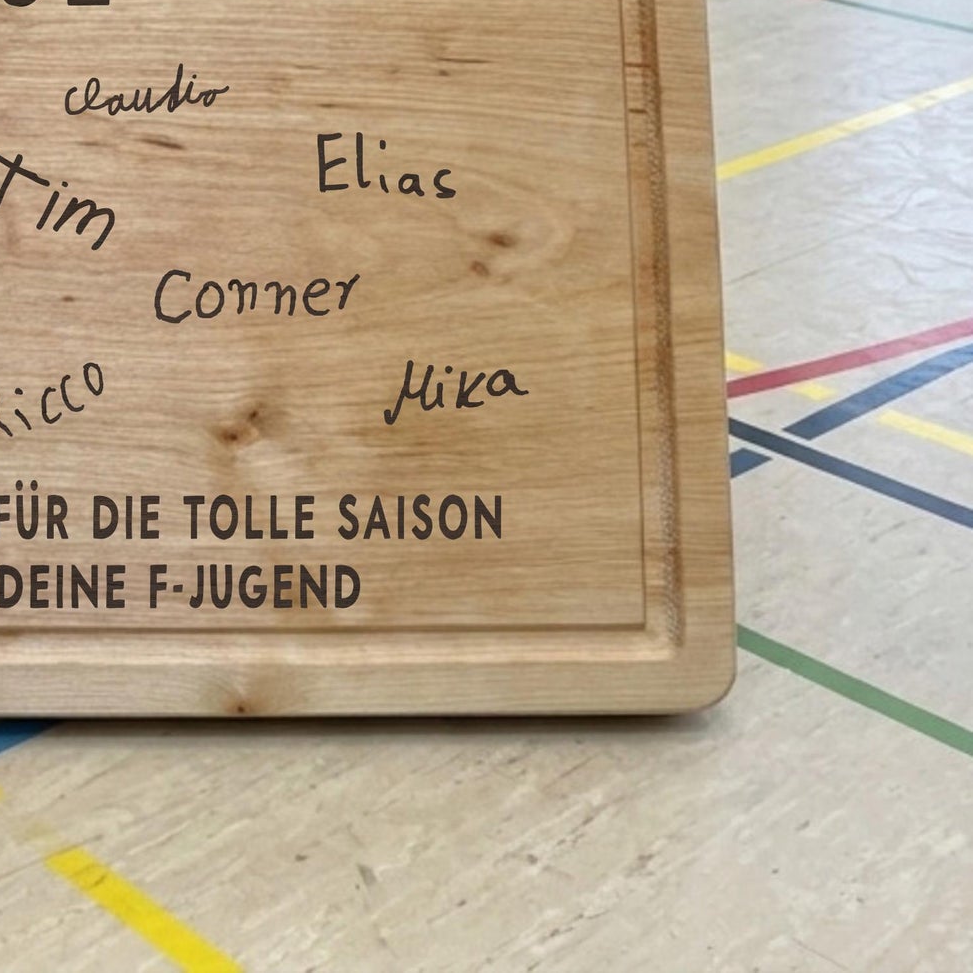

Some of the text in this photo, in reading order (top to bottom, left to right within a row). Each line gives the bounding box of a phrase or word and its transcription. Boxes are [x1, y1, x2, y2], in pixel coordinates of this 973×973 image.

[318, 132, 456, 198] Elias
[155, 270, 360, 323] Conner
[384, 360, 529, 425] Mika
[93, 496, 159, 539] DIE
[184, 495, 314, 540] TOLLE
[338, 494, 501, 540] SAISON
[150, 565, 360, 608] F-JUGEND
